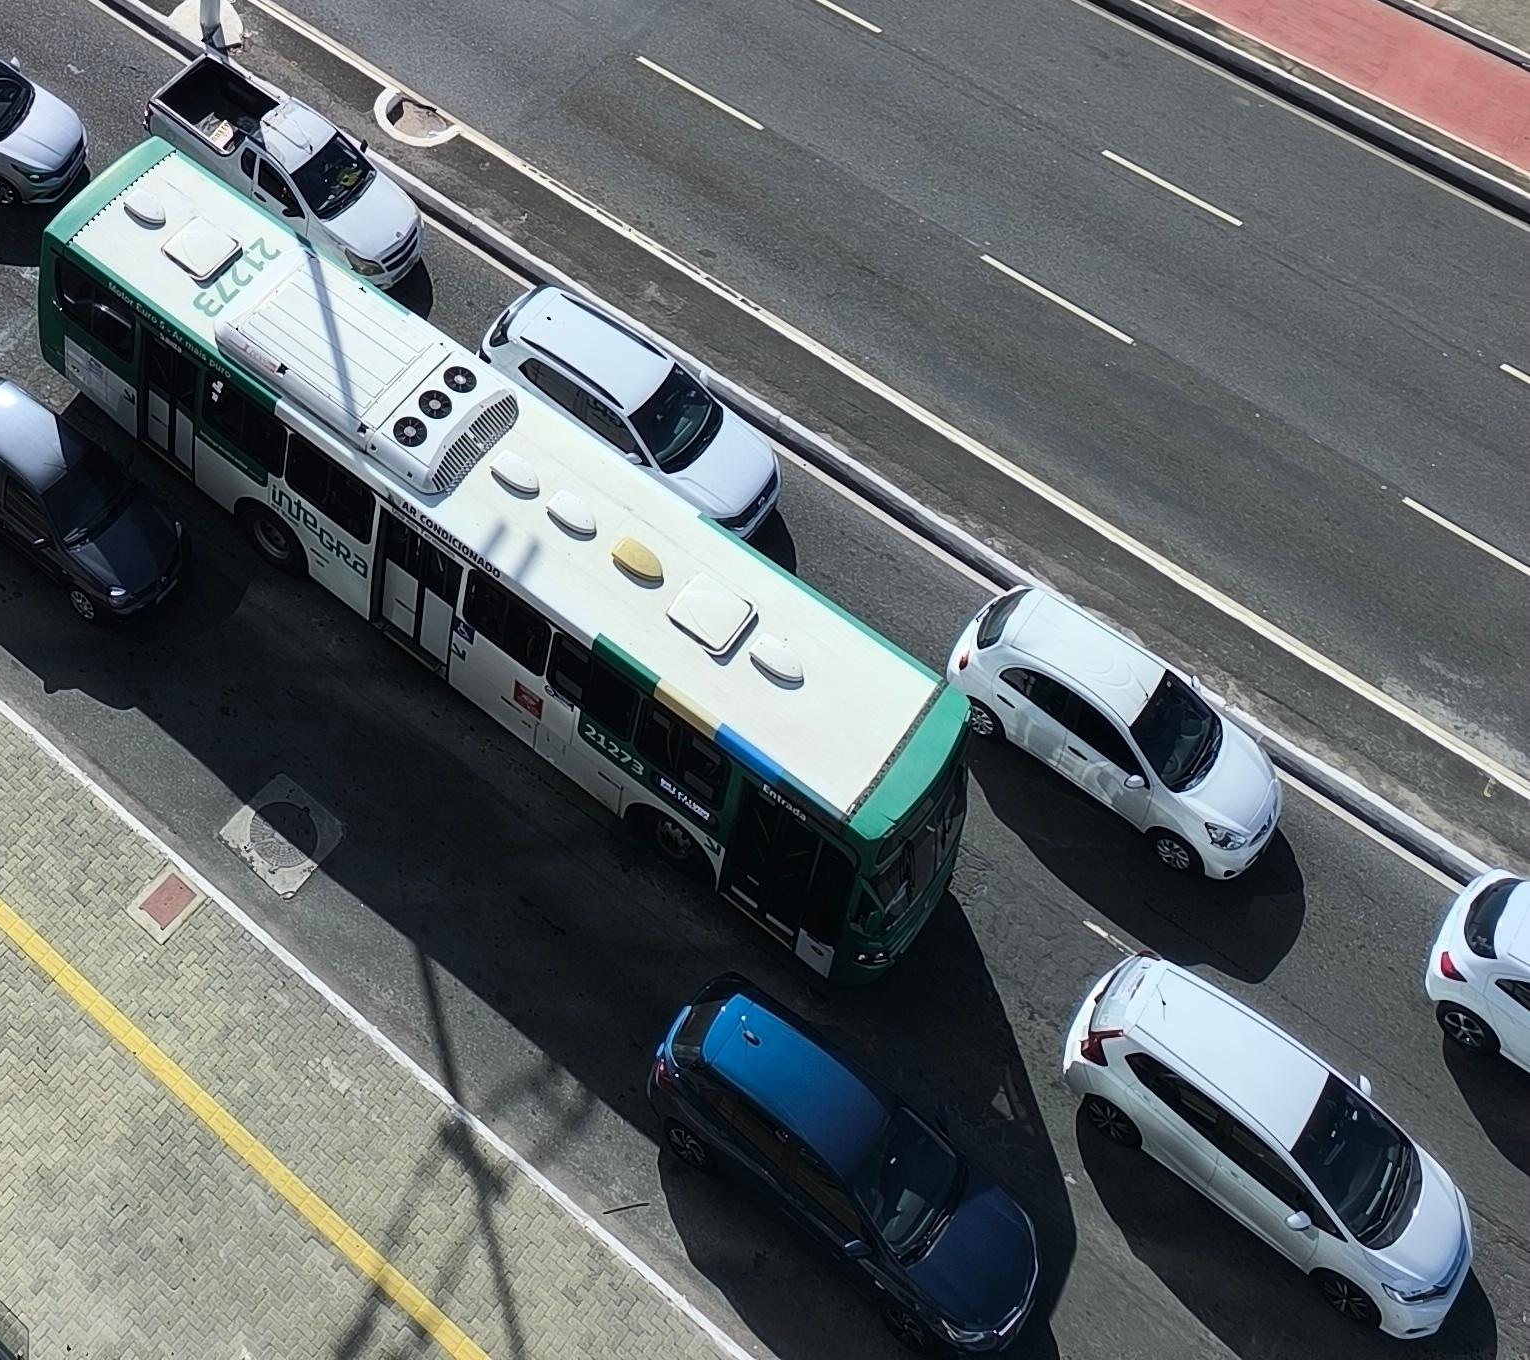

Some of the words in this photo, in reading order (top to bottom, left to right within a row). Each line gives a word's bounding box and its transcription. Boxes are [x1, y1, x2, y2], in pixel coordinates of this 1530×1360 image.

[193, 237, 282, 318] 21273
[108, 282, 135, 307] Motor
[136, 303, 158, 325] Euro
[172, 330, 183, 343] Ar
[184, 339, 208, 362] mais
[208, 359, 232, 380] puro
[401, 501, 418, 517] AR
[419, 514, 501, 579] CONDICIONADO
[584, 723, 645, 776] 21273
[763, 784, 808, 822] Entrada
